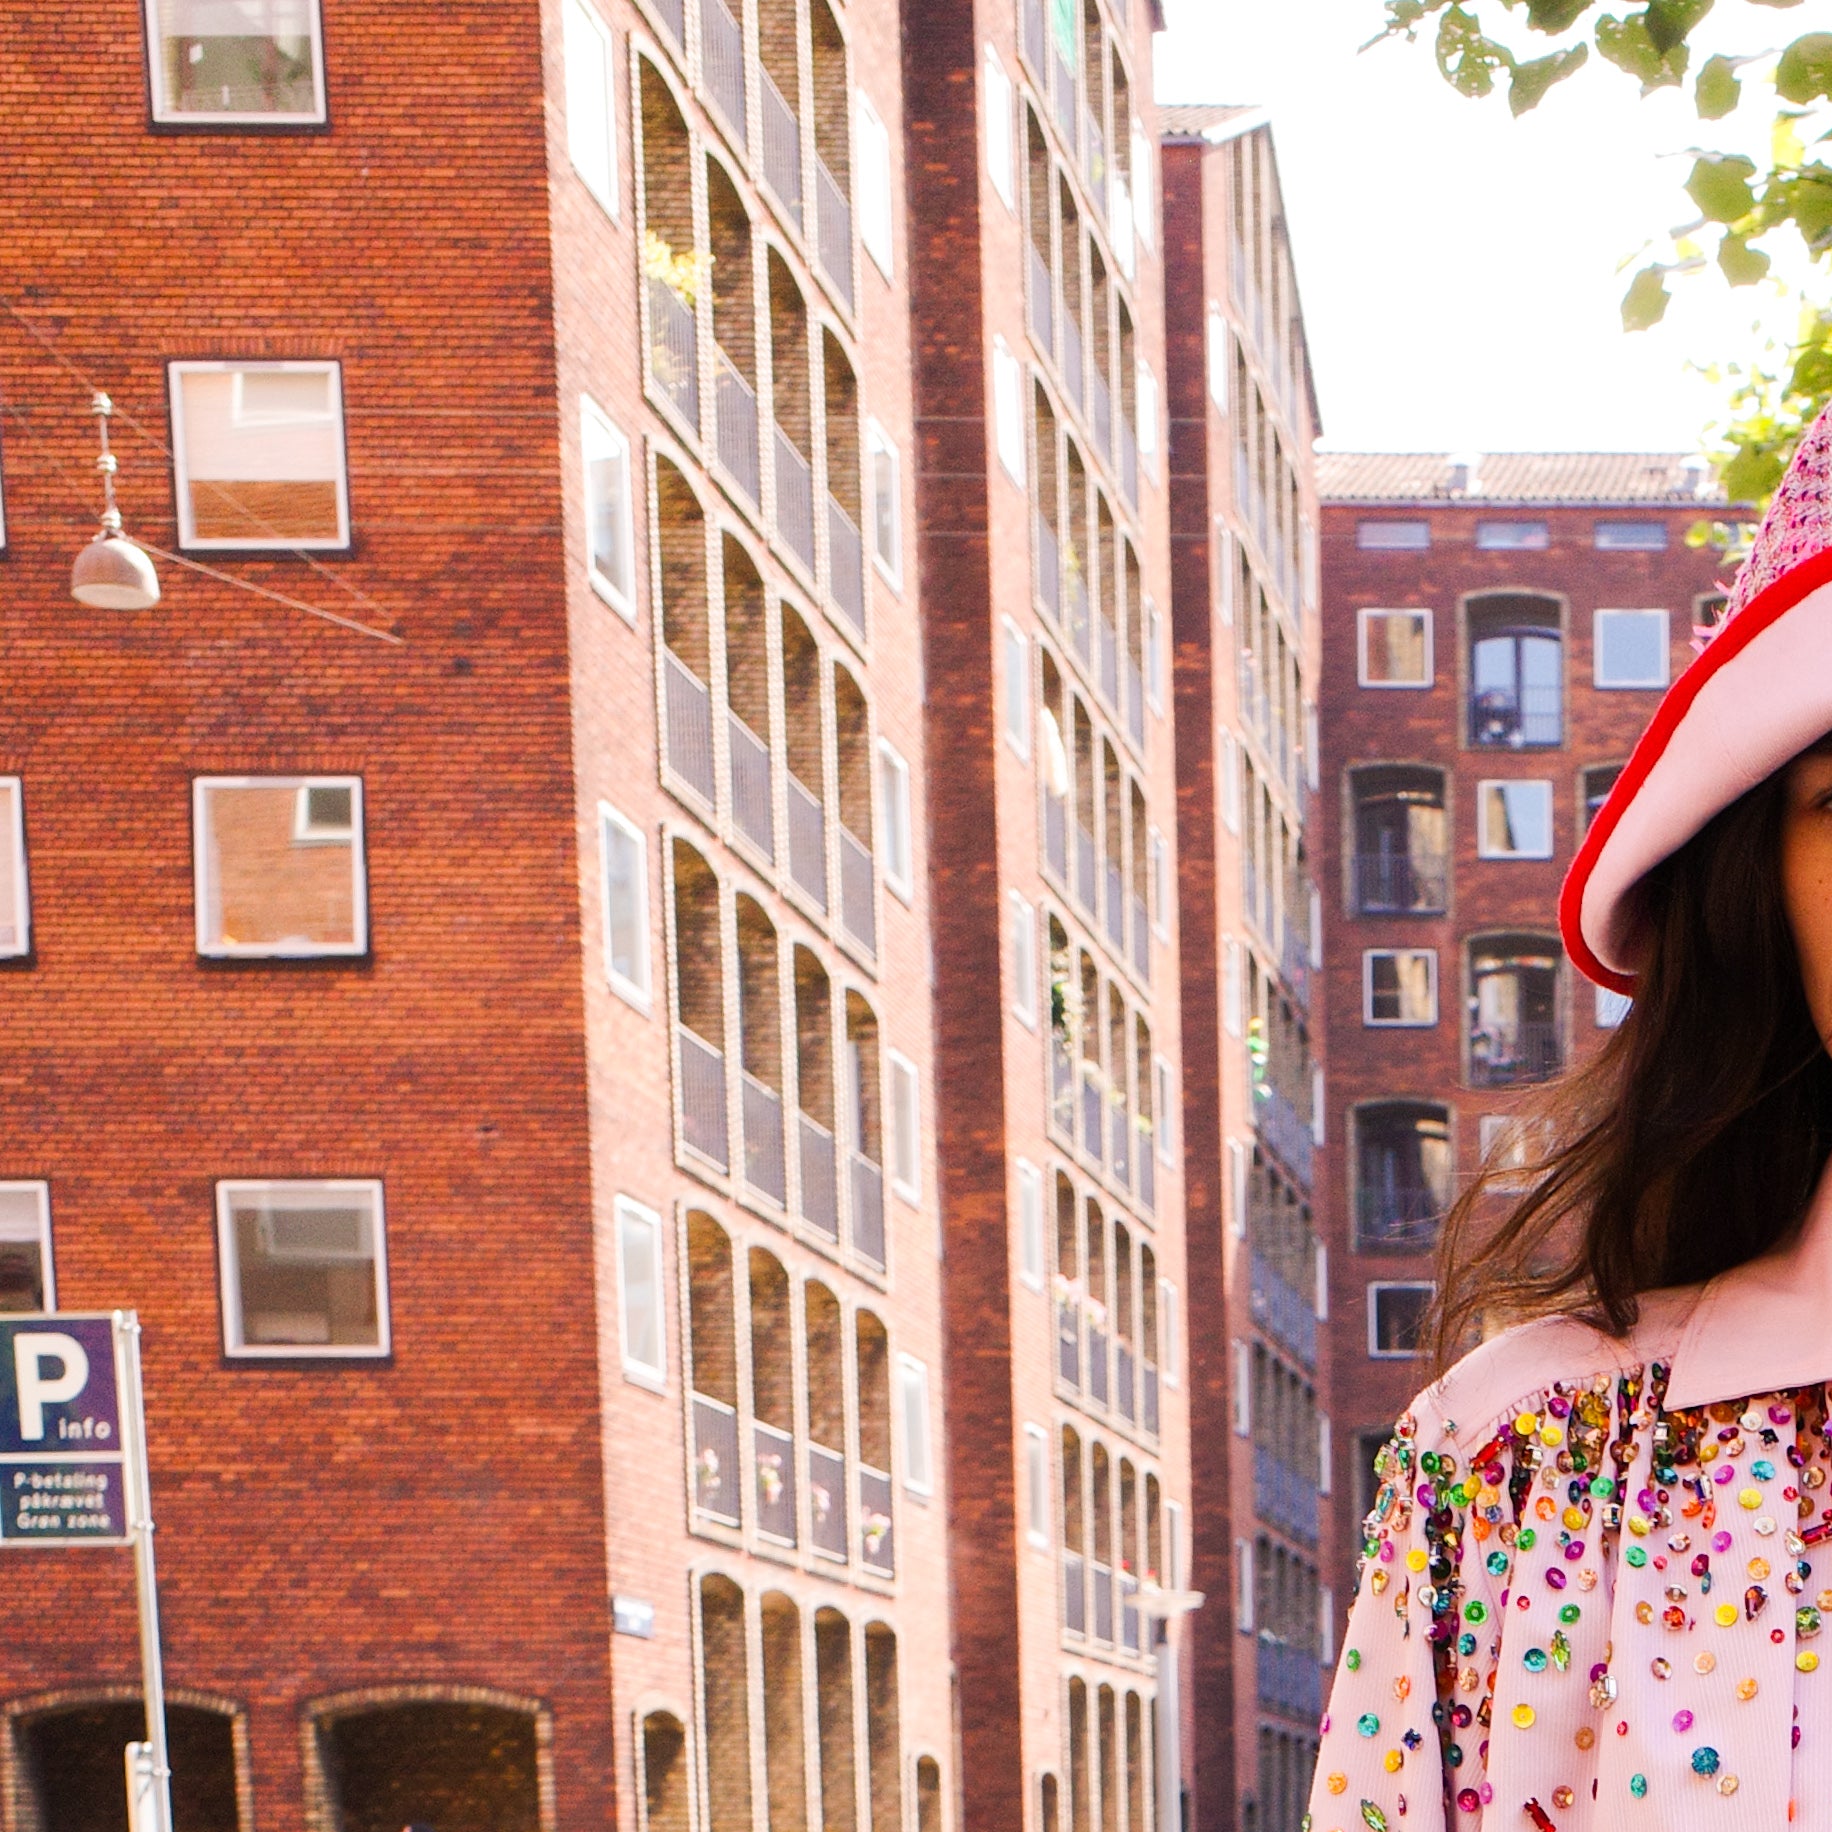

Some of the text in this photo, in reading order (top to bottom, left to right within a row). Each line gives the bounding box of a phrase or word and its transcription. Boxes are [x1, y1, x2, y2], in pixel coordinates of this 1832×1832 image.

[14, 1332, 89, 1441] P
[13, 1471, 108, 1491] P-betaling
[66, 1514, 110, 1529] zone
